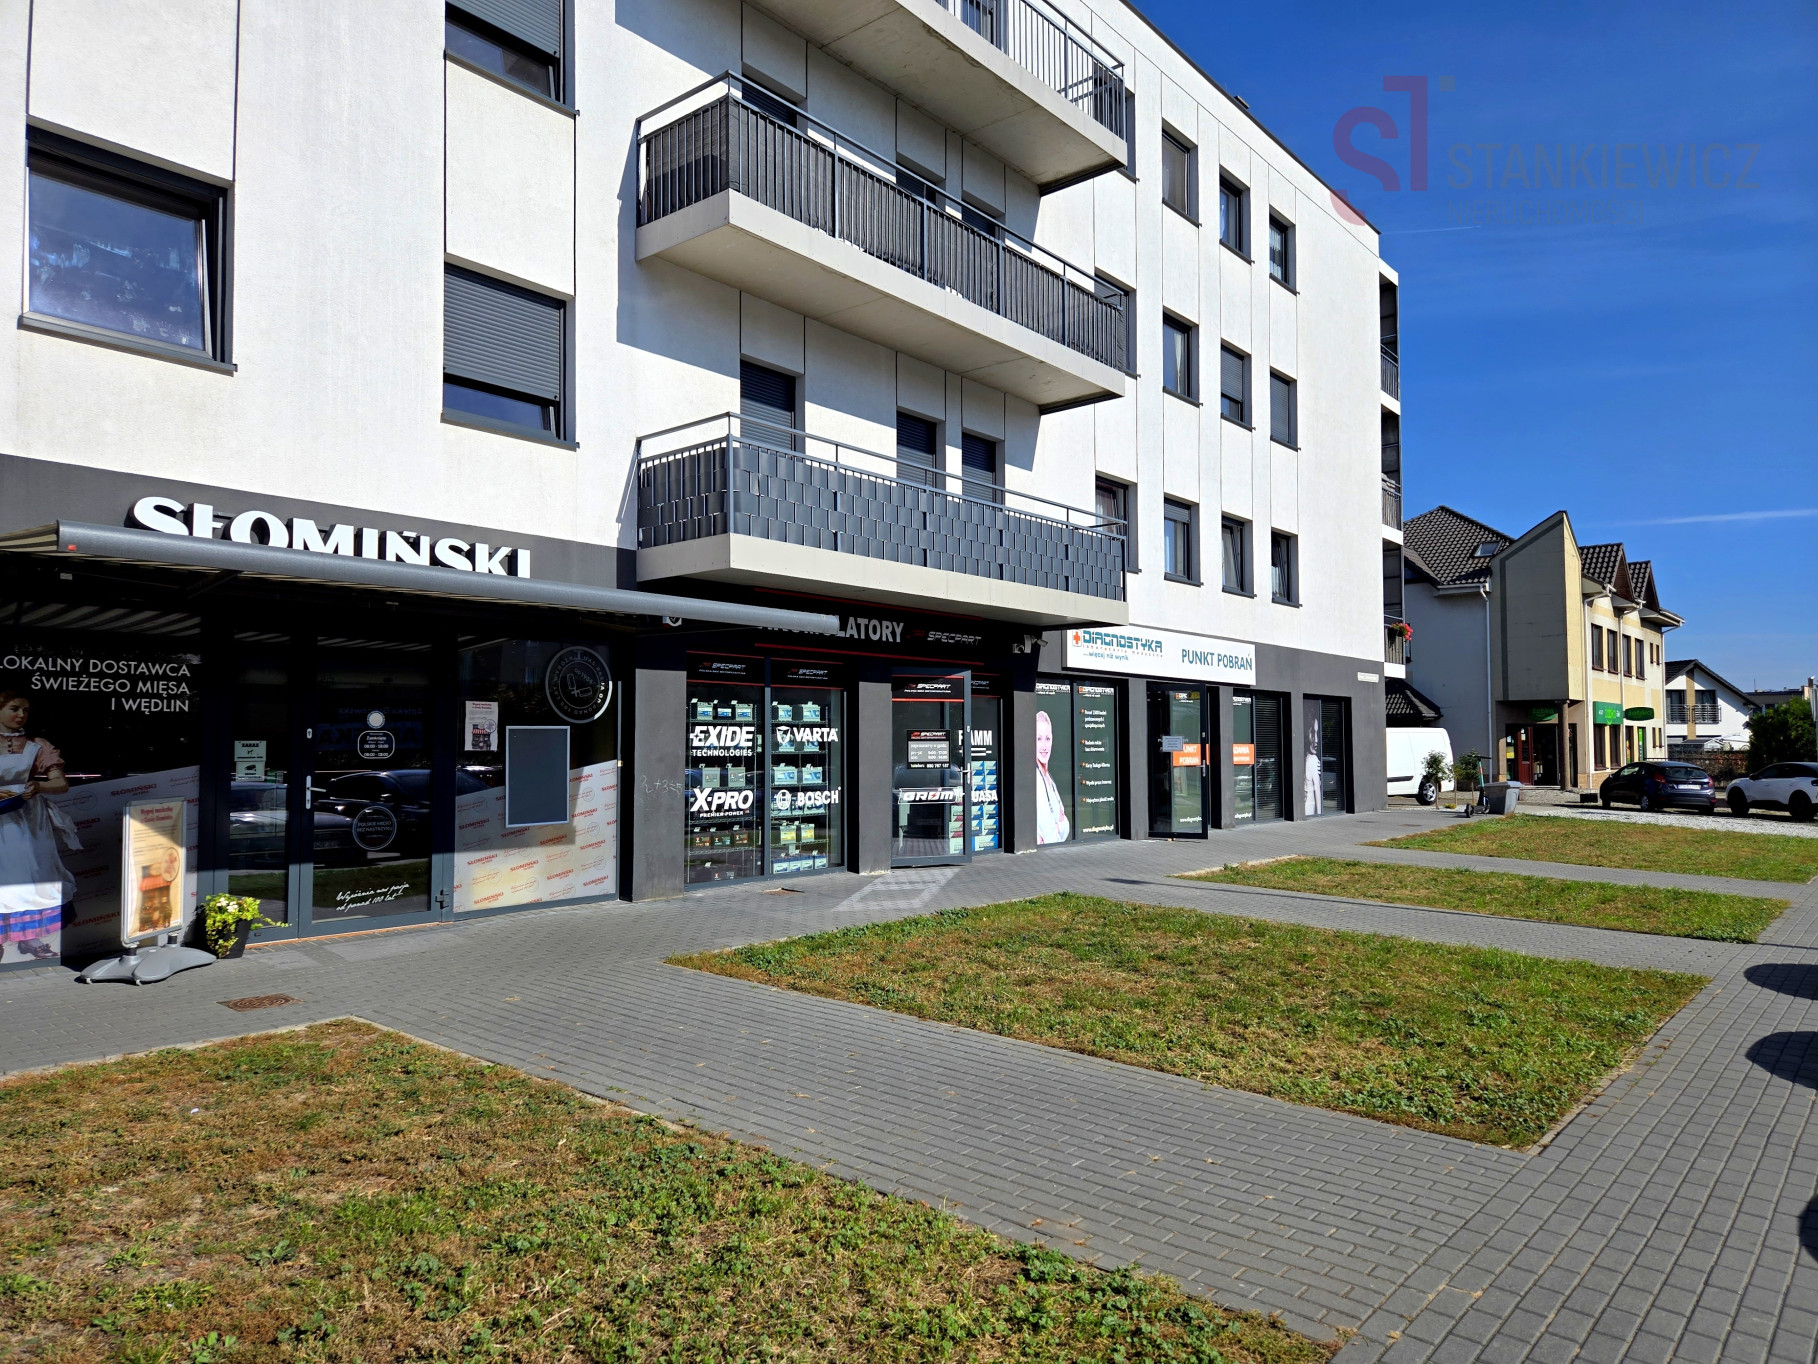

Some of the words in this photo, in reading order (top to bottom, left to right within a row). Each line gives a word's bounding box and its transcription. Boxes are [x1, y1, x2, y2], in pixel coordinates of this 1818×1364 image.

[133, 496, 531, 578] SŁOMIŃSKI
[927, 630, 982, 645] SPECPART
[89, 659, 191, 677] DOSTAWCA
[1181, 649, 1215, 667] PUNKT
[1217, 653, 1253, 671] POBRAŃ
[31, 672, 131, 692] ŚWIEŻEGO
[136, 680, 190, 697] MIĘSA
[111, 698, 115, 710] I
[121, 698, 189, 715] WĘDLIN
[690, 725, 755, 747] EXIDE
[793, 727, 838, 742] VARTA
[692, 749, 752, 757] TECHNOLOGIES
[690, 788, 754, 812] X-PRO
[797, 790, 839, 806] BOSCH
